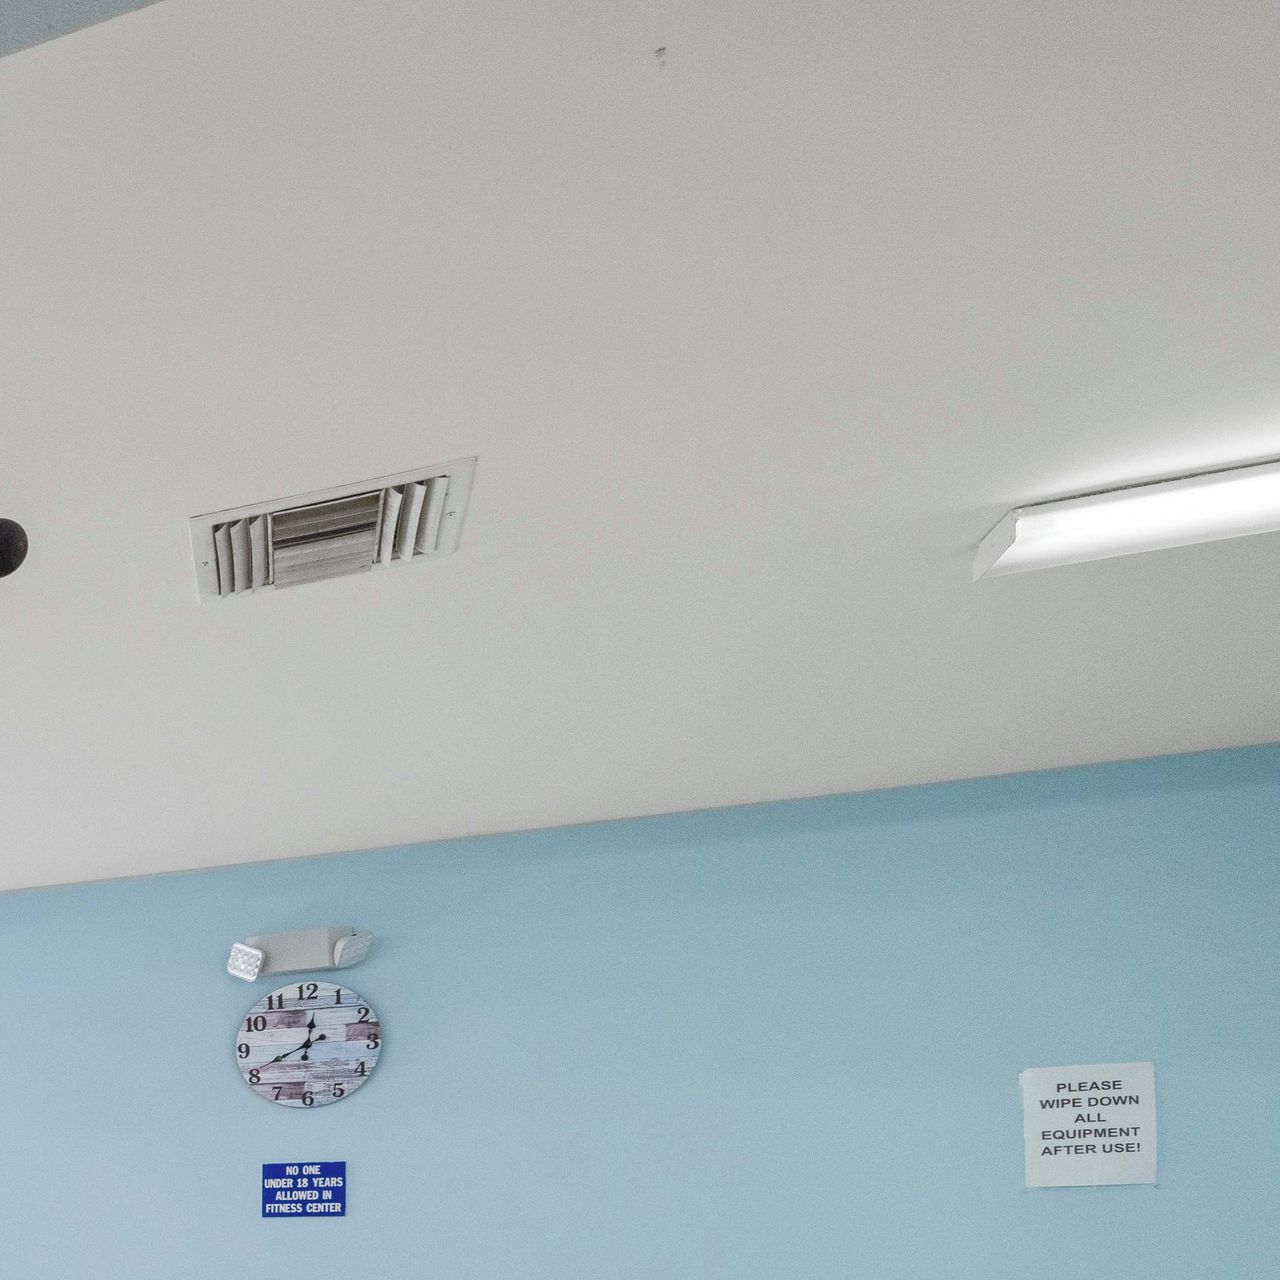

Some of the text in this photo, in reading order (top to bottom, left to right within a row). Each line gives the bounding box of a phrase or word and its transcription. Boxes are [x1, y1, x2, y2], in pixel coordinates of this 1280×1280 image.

[297, 983, 318, 1000] 12
[334, 988, 341, 1004] 1
[266, 993, 284, 1010] 11
[357, 1007, 370, 1023] 2
[245, 1015, 267, 1032] 10
[366, 1033, 379, 1050] 3
[237, 1043, 250, 1059] 9
[248, 1068, 261, 1084] 8
[354, 1061, 368, 1077] 4
[271, 1086, 282, 1100] 7
[333, 1082, 345, 1098] 5
[1056, 1079, 1122, 1093] PLEASE
[301, 1091, 314, 1106] 6
[1040, 1095, 1139, 1109] WIPE DOWN
[1074, 1112, 1107, 1123] ALL
[1041, 1126, 1140, 1140] EQUIPMENT
[1040, 1142, 1140, 1156] AFTER USE!
[285, 1164, 321, 1175] NO ONE
[264, 1177, 343, 1188] UNDER 18 YEARS
[275, 1190, 332, 1200] ALLOWED IN
[265, 1202, 342, 1213] FITNESS CENTER
